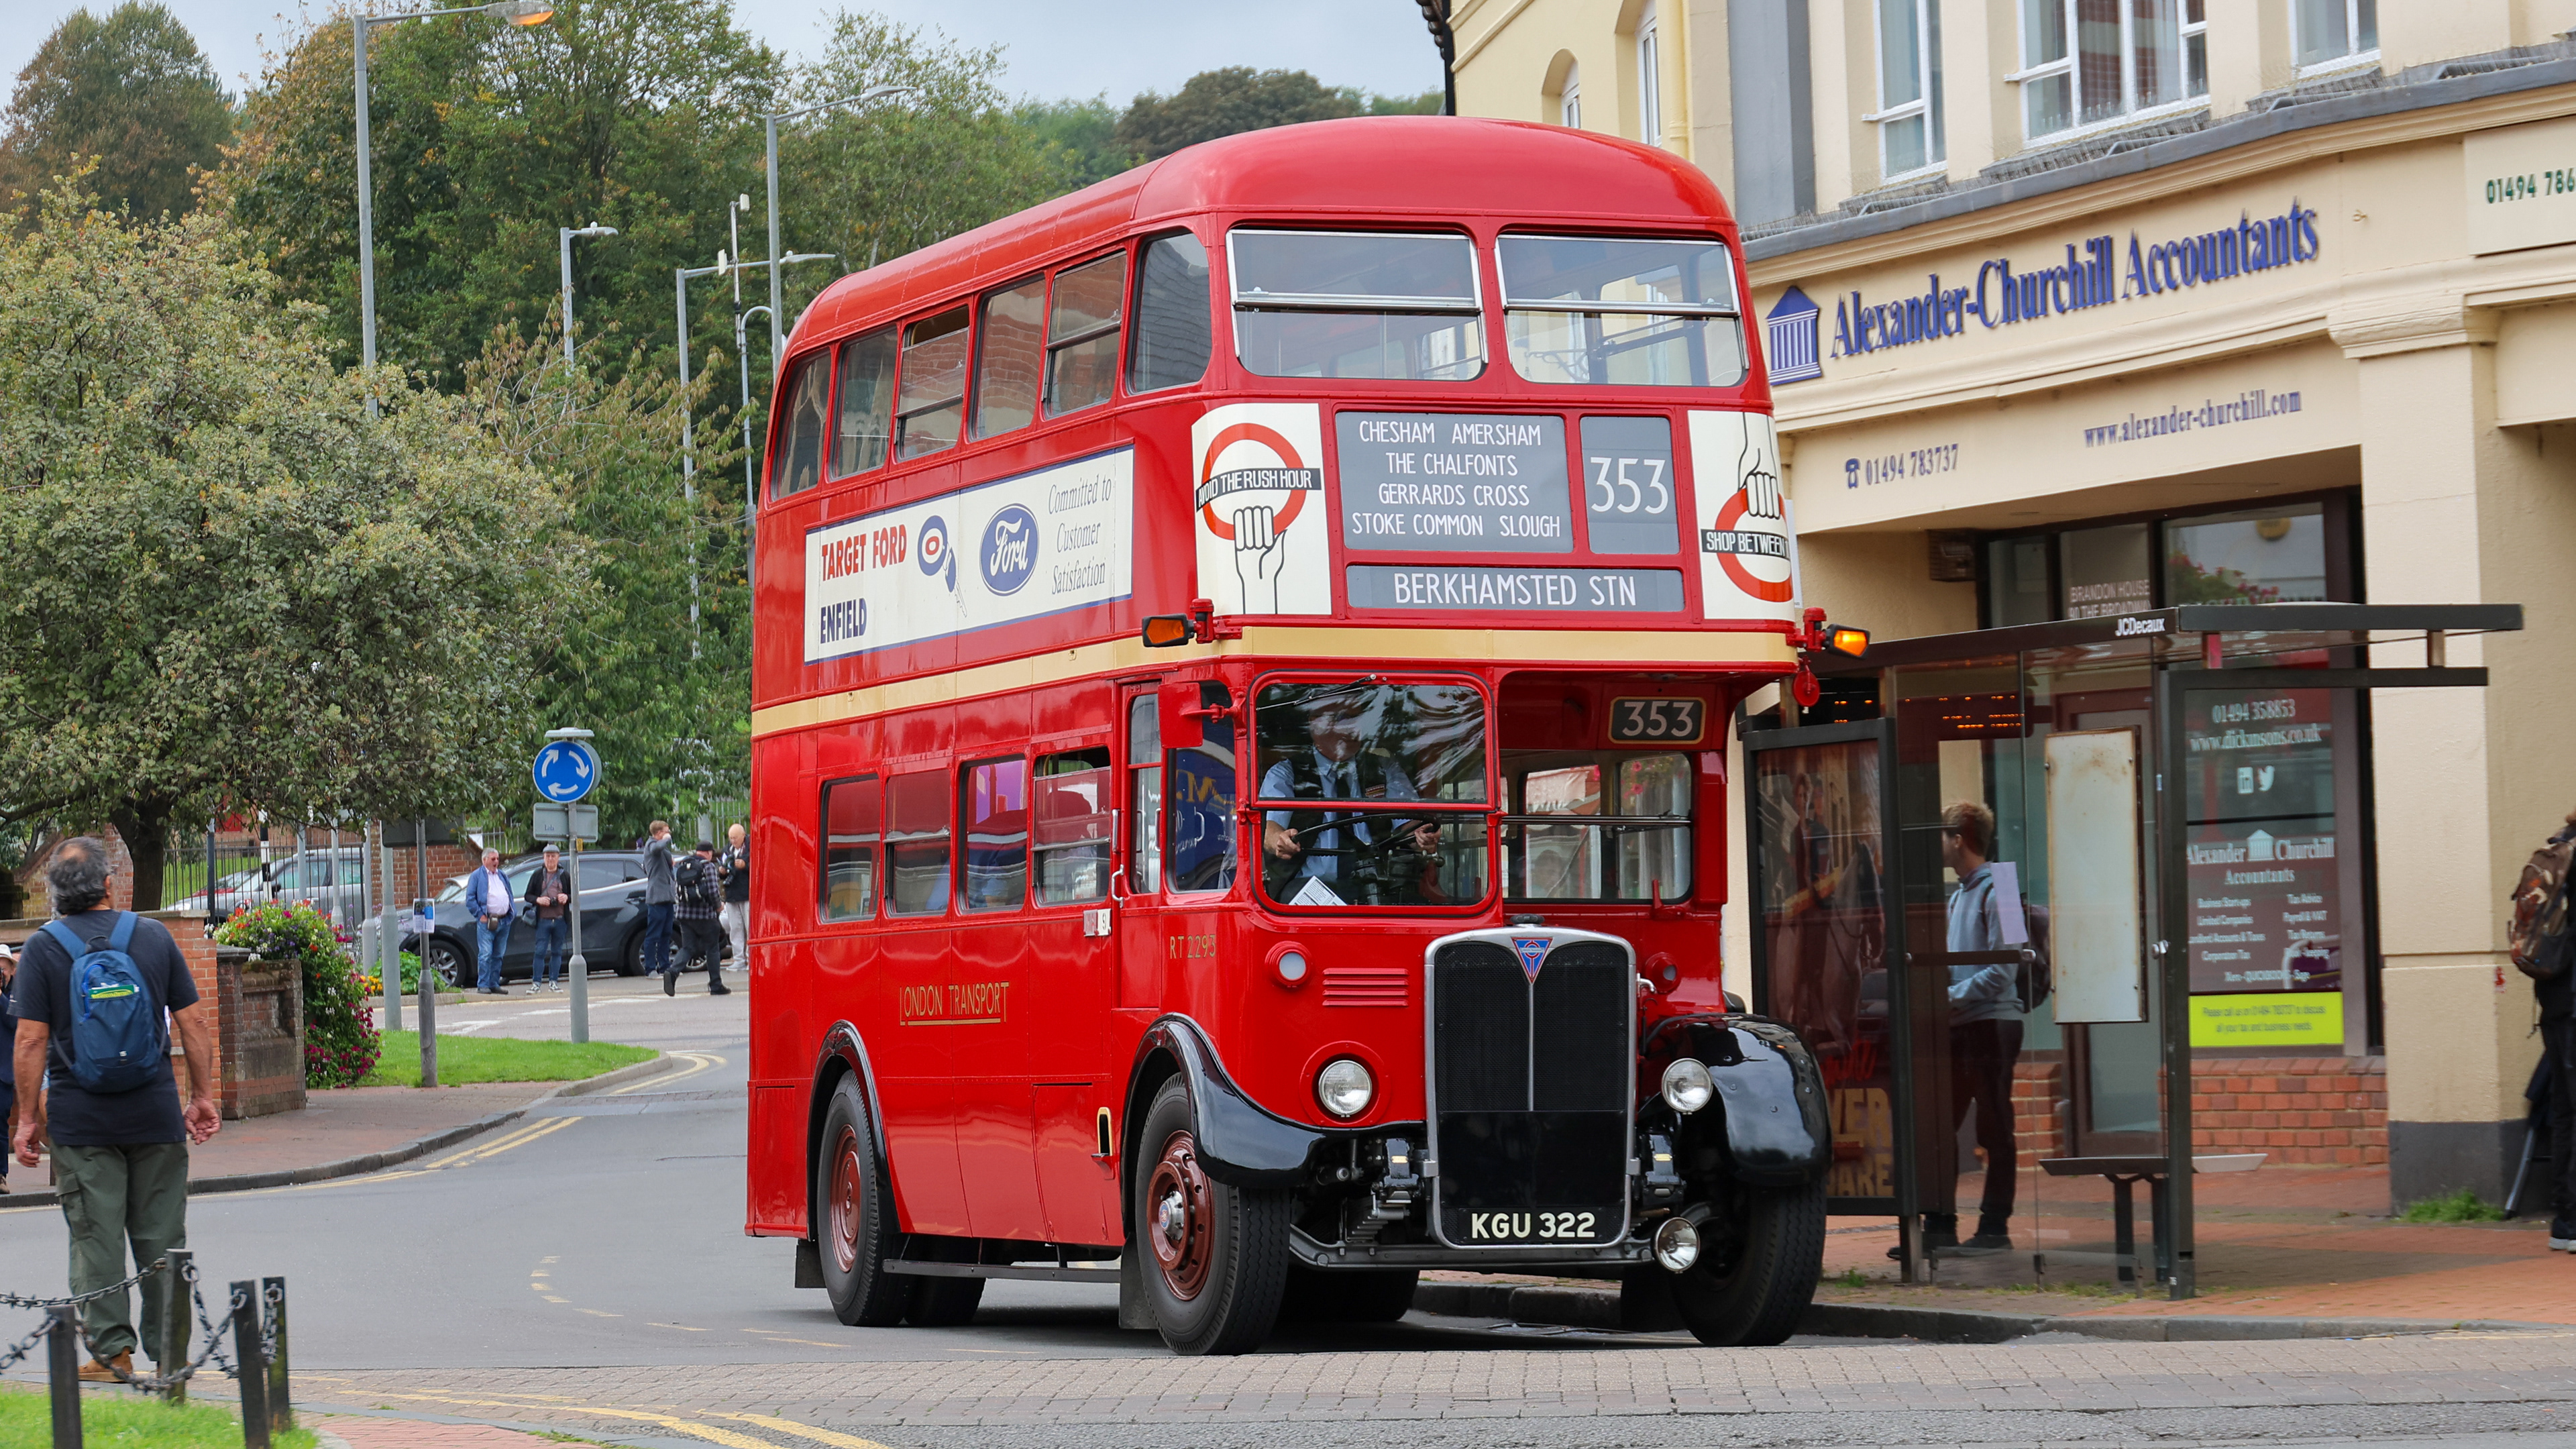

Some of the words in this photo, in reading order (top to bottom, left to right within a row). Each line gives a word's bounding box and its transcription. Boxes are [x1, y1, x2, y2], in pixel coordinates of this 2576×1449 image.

[2487, 173, 2536, 204] 01494
[1830, 235, 2115, 359] Alexander-Churchill
[2121, 196, 2319, 300] Accountants
[1359, 420, 1436, 444] CHESHAM
[1452, 423, 1542, 445] AMERSHAM
[2084, 388, 2303, 449] www.alexander-churchill.com
[1385, 451, 1416, 475] THE
[1423, 453, 1519, 476] CHALFONTS
[1866, 453, 1904, 486] 01494
[1911, 443, 1959, 478] 783737
[1049, 474, 1098, 515] Committed
[1101, 477, 1112, 501] to
[1198, 474, 1218, 508] AVOID
[1220, 470, 1242, 491] THE
[1244, 470, 1278, 489] RUSH
[1280, 469, 1313, 488] HOUR
[1379, 483, 1466, 506] GERRARDS
[1474, 485, 1530, 506] CROSS
[1590, 457, 1669, 515] 353
[1057, 523, 1101, 553] Customer
[1352, 513, 1406, 535] STOKE
[1413, 514, 1484, 536] COMMON
[1499, 515, 1560, 537] SLOUGH
[822, 533, 867, 582] TARGET
[872, 524, 908, 569] FORD
[990, 517, 1030, 576] Ford
[1706, 531, 1736, 552] SHOP
[1739, 533, 1785, 557] BETWEEN
[1051, 557, 1106, 595] Satisfaction
[1394, 573, 1577, 606] BERKHAMSTED
[1590, 576, 1637, 606] STN
[2070, 582, 2116, 602] BRANDON
[2118, 579, 2150, 597] HOUSE
[820, 598, 867, 644] ENFIELD
[2082, 604, 2100, 618] THE
[2115, 616, 2165, 637] JCDecaux
[1622, 700, 1695, 737] 353
[2212, 702, 2250, 724] 01494
[2187, 841, 2246, 865] Alexander
[2275, 837, 2334, 861] Churchill
[2224, 868, 2296, 885] Accountants
[1169, 935, 1184, 960] RT
[1187, 934, 1216, 959] 2293
[900, 985, 943, 1026] LONDON
[949, 981, 1009, 1022] TRANSPORT
[1471, 1213, 1531, 1239] KGU
[1539, 1212, 1595, 1238] 322
